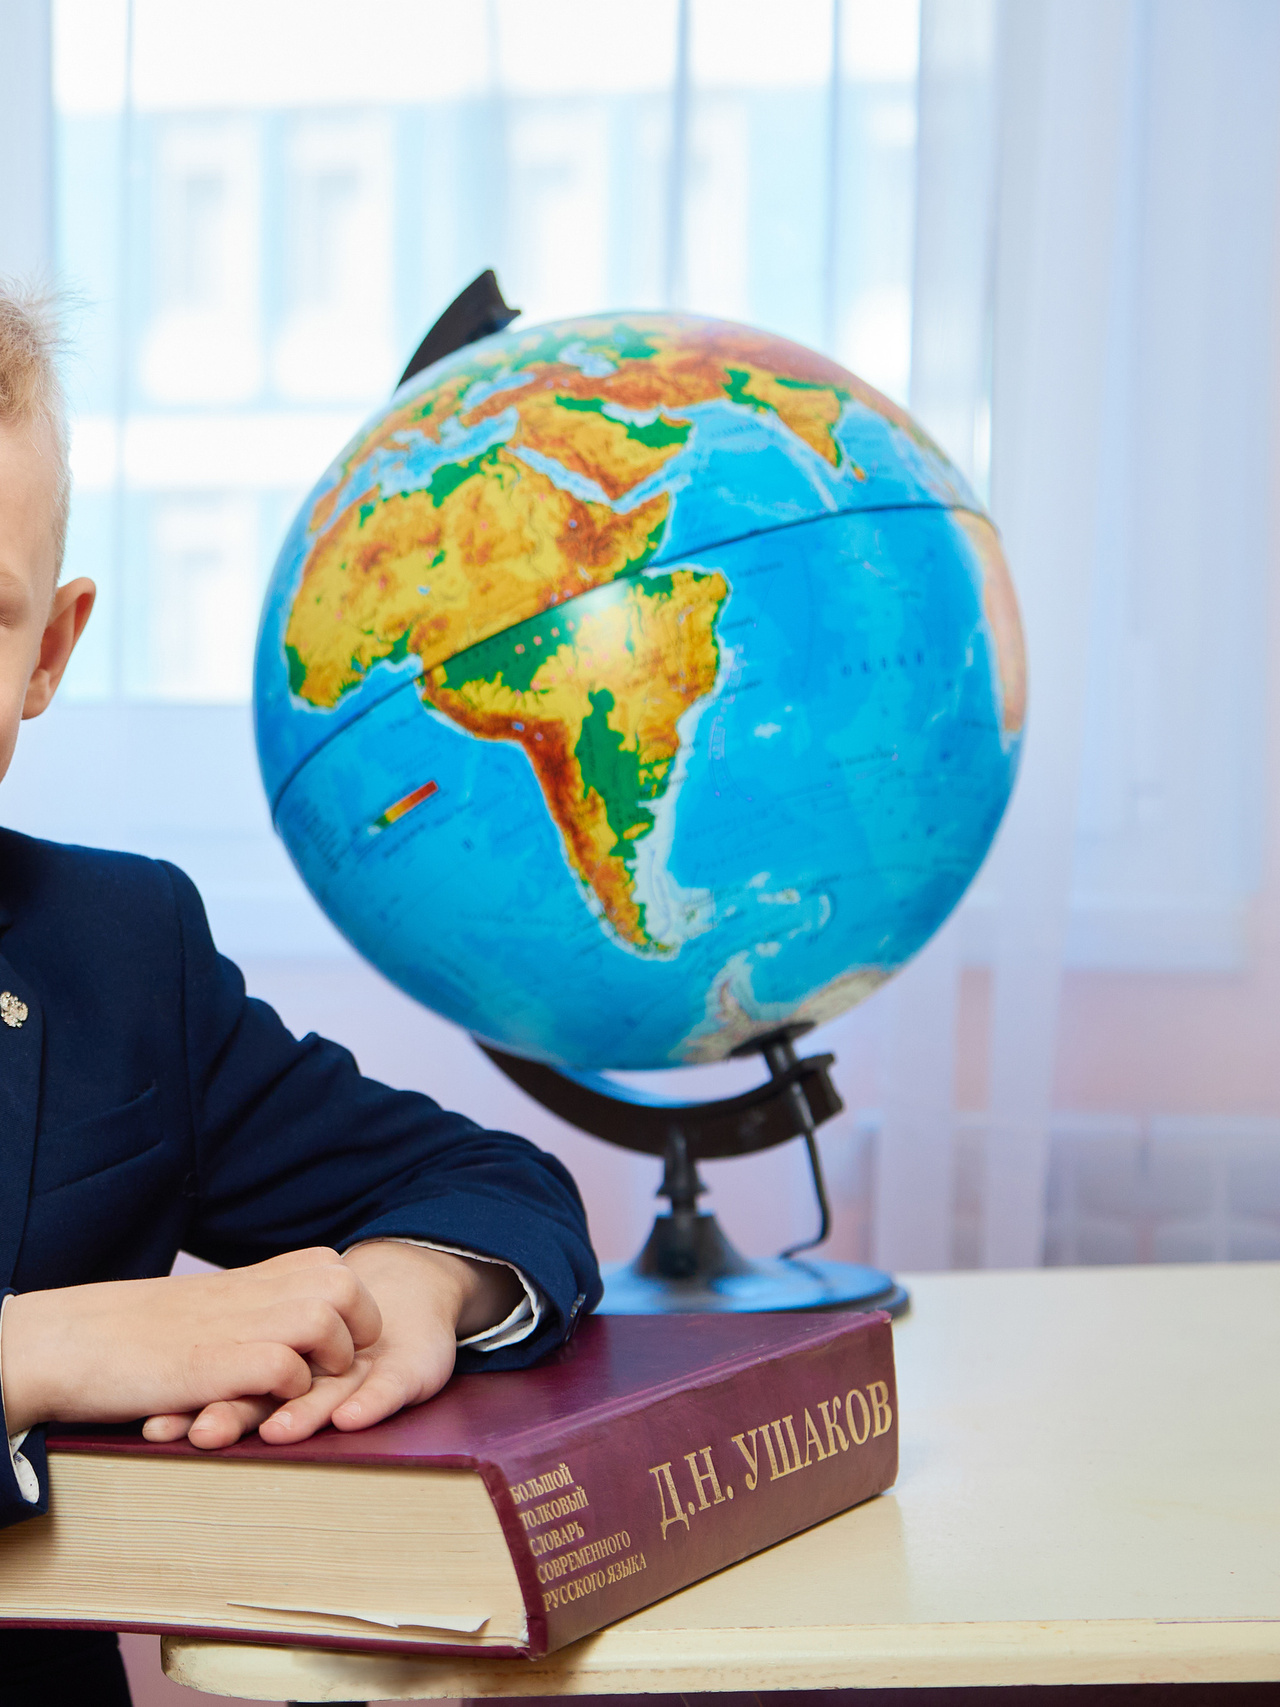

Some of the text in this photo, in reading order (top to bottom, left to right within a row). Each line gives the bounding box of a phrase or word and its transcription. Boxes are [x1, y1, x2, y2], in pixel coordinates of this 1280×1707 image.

[509, 1463, 574, 1505] БОЛЬШОЙ
[648, 1380, 893, 1541] Д.Н. УШАКОВ
[518, 1486, 589, 1530] ТОЛКОВЫЙ
[529, 1521, 585, 1557] СЛОВАРЬ
[536, 1530, 631, 1584] СОВРЕМЕННОГО
[542, 1552, 647, 1612] РУССКОГО ЯЗЫКА
